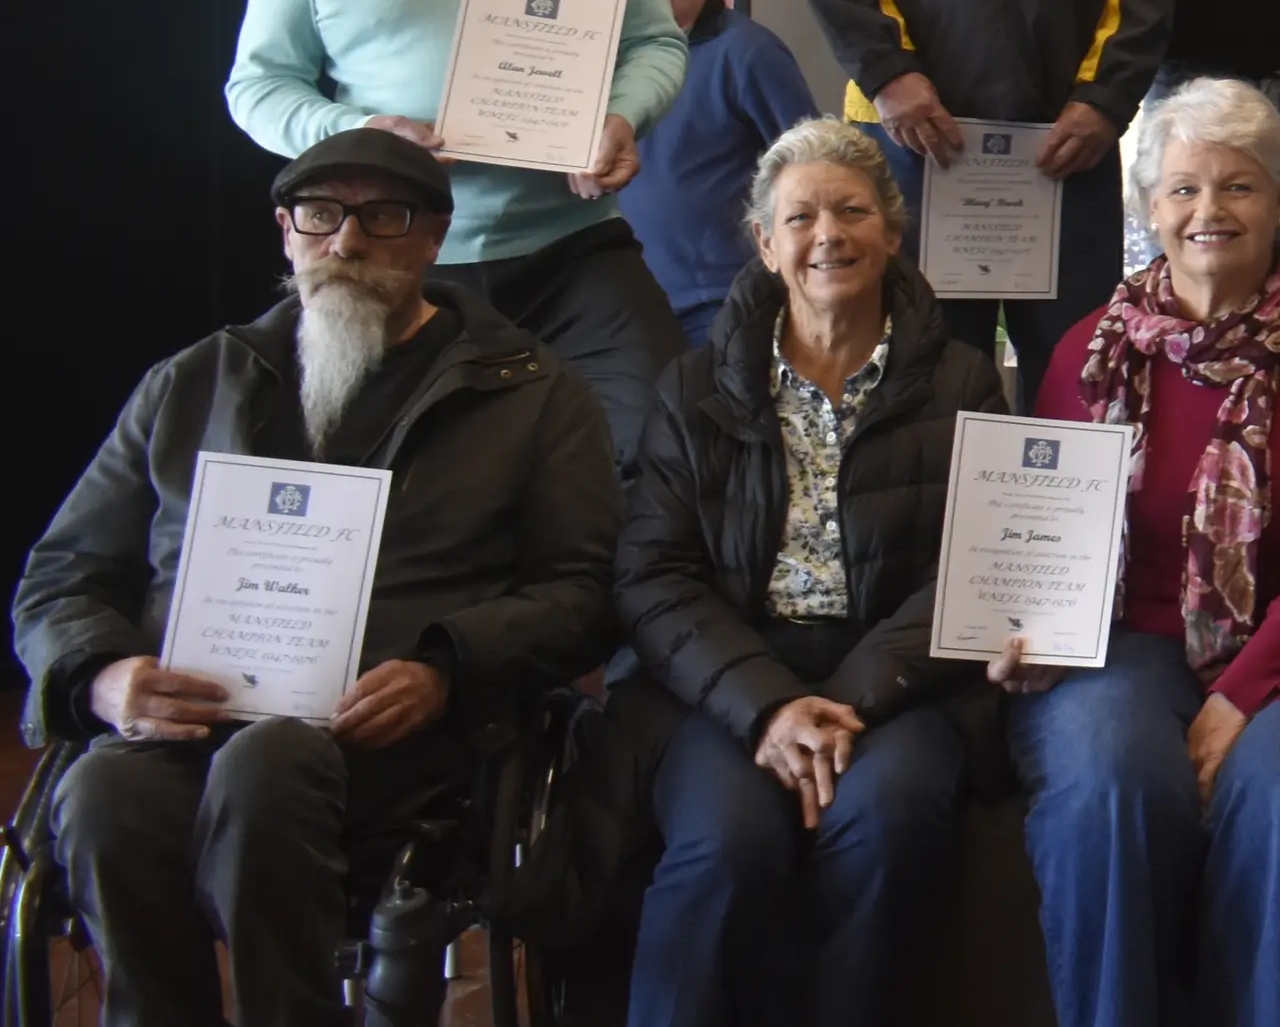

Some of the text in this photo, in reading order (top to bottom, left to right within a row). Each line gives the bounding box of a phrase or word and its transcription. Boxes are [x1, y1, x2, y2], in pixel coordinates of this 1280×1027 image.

[973, 469, 1107, 493] MANSFIELD FC
[213, 515, 360, 542] MANSFIELD FC
[999, 526, 1061, 543] Jim James
[989, 561, 1070, 575] MANSFIELD
[234, 576, 259, 592] Jim
[967, 574, 1087, 592] CHAMPION TEAM
